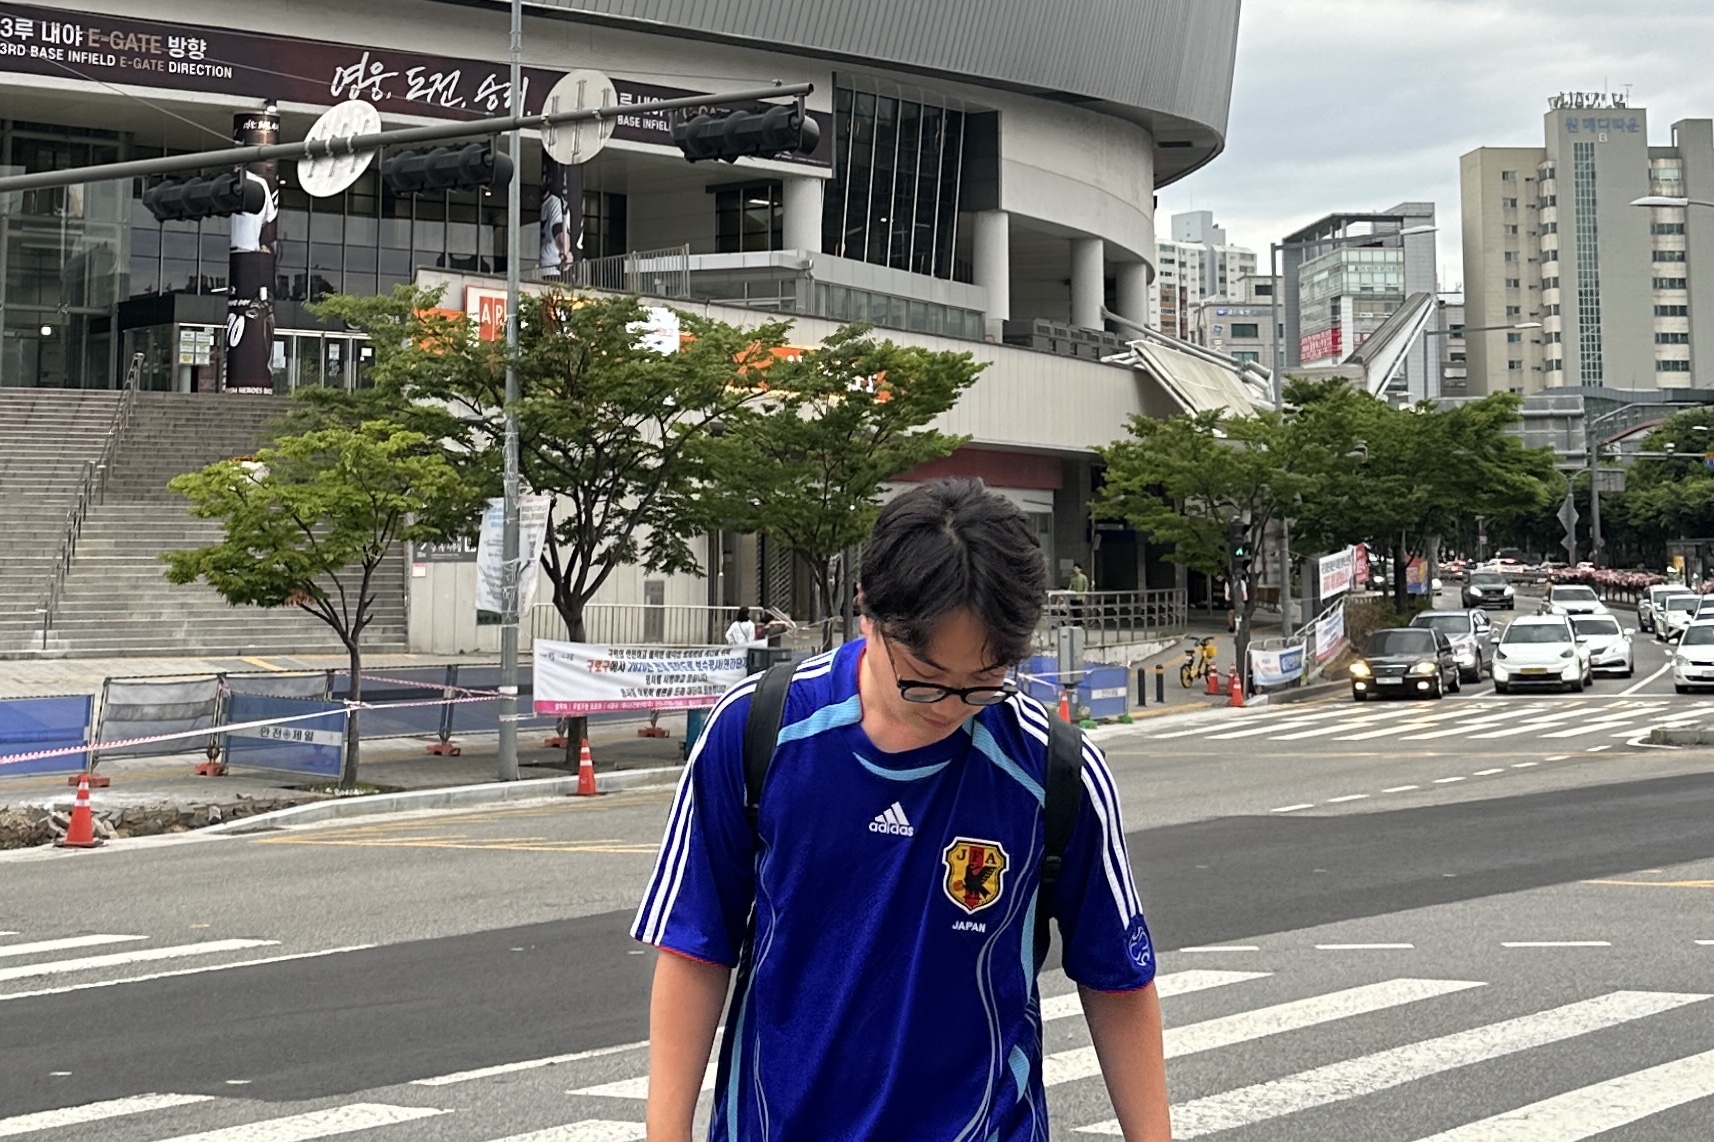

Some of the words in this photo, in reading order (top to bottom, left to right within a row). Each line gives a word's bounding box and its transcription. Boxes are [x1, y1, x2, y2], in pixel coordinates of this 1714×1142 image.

[0, 18, 33, 41] 3루
[41, 21, 83, 47] 내야
[88, 28, 162, 54] E-GATE
[168, 35, 207, 60] 방향
[0, 43, 26, 57] 3RD
[30, 48, 64, 61] BASE
[68, 50, 116, 67] INFIELD
[119, 56, 164, 72] E-GATE
[168, 62, 232, 79] DIRECTION
[617, 115, 640, 128] BASE
[643, 118, 671, 132] INFIEL
[587, 659, 626, 672] 구로구에서
[260, 726, 281, 739] 안전
[293, 729, 314, 741] 제일
[869, 821, 914, 837] adidas
[952, 920, 986, 933] JAPAN
